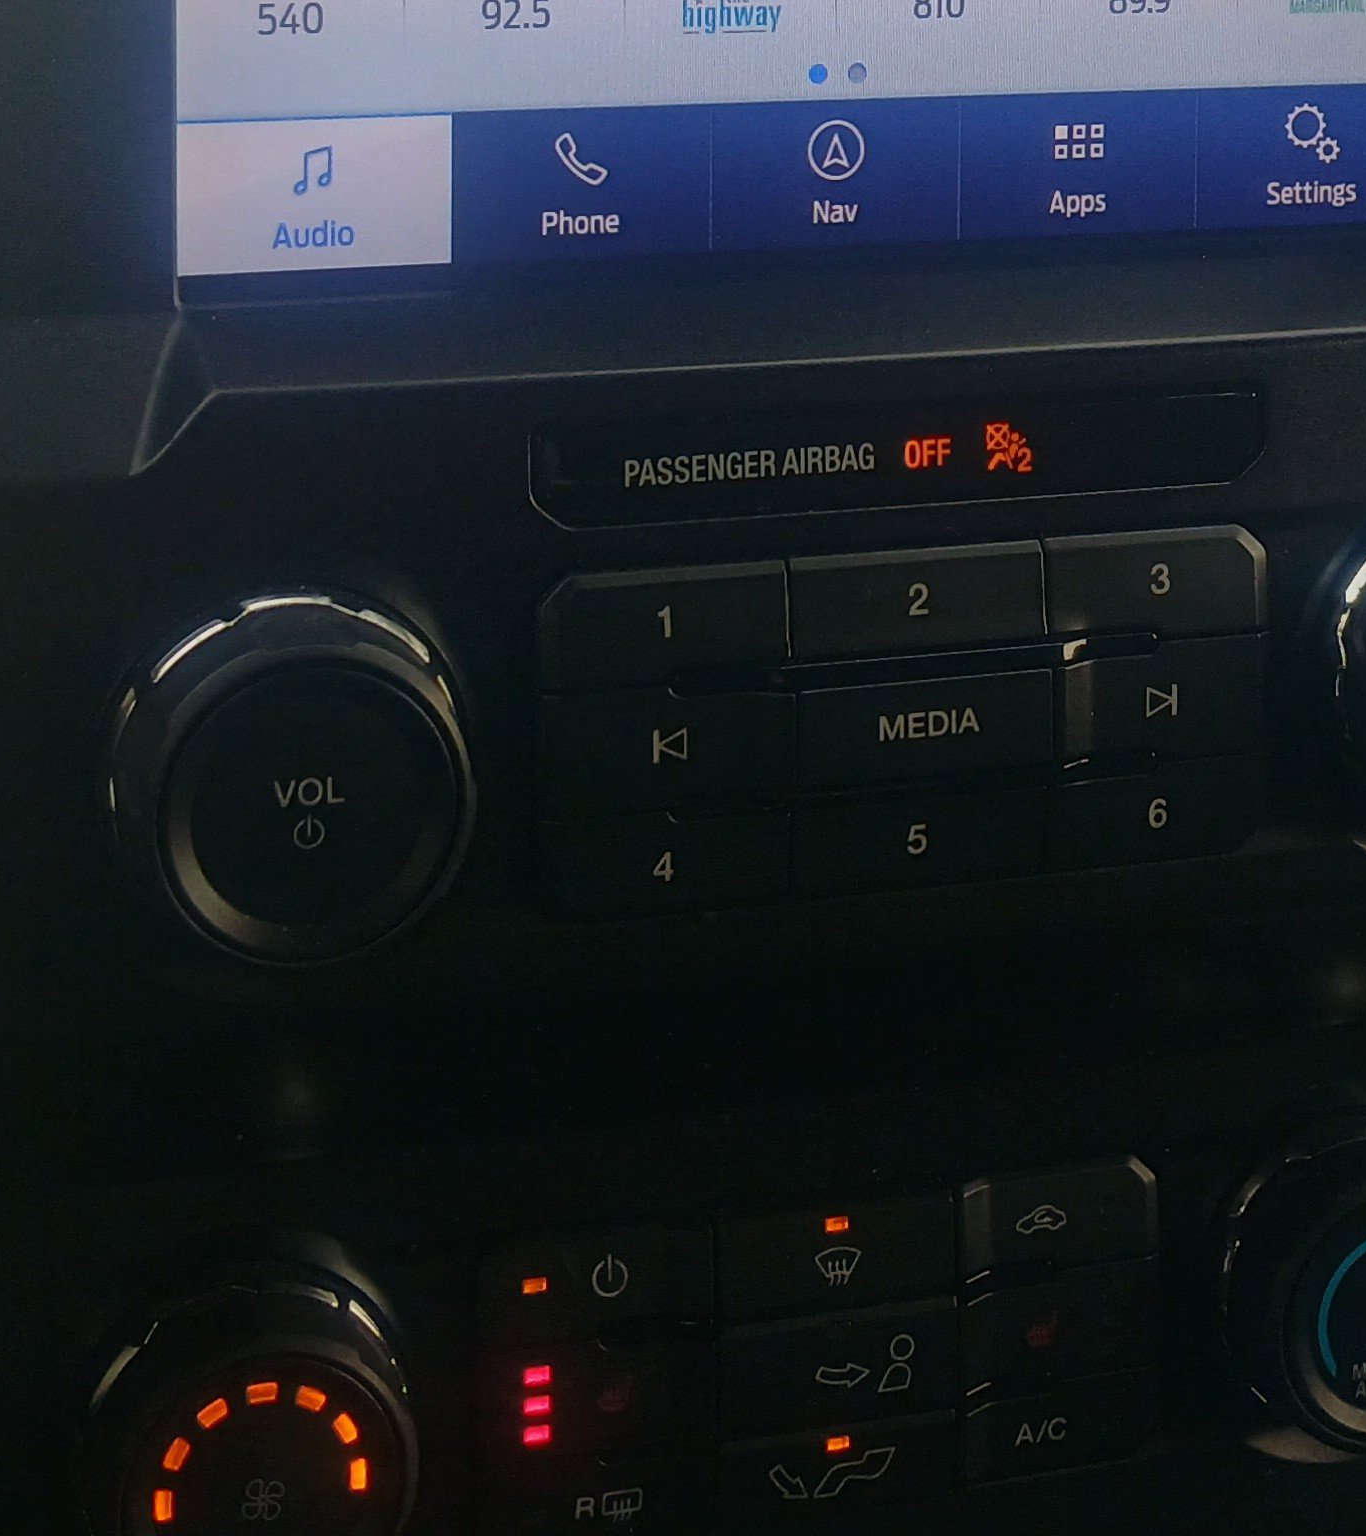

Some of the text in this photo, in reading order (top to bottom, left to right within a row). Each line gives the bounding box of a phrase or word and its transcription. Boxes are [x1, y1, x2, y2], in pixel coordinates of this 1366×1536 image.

[257, 3, 324, 36] 540
[1049, 191, 1106, 217] Apps
[1266, 179, 1357, 207] Settings
[541, 210, 620, 236] Phone
[812, 200, 858, 224] Nav
[272, 219, 355, 250] Audio
[623, 452, 777, 488] PASSENGER
[782, 442, 876, 476] AIRBAG
[904, 436, 952, 470] OFF
[1150, 564, 1172, 596] 3
[908, 584, 930, 616] 2
[656, 606, 675, 638] 1
[879, 708, 980, 742] MEDIA
[273, 776, 345, 808] VOL
[1149, 798, 1169, 829] 6
[906, 825, 929, 857] 5
[652, 851, 676, 882] 4
[1015, 1417, 1067, 1447] A/C
[575, 1497, 595, 1520] R
